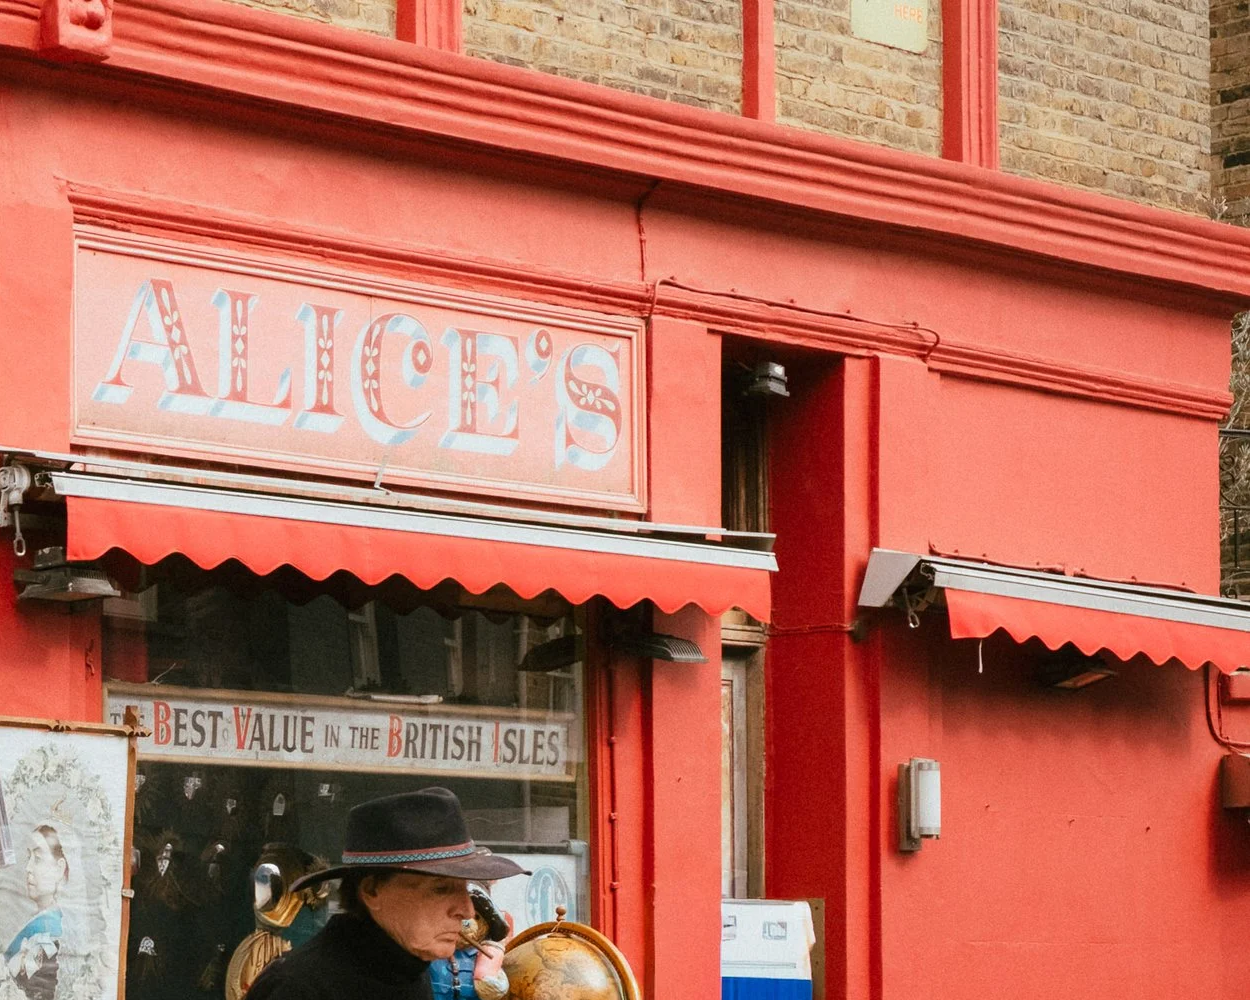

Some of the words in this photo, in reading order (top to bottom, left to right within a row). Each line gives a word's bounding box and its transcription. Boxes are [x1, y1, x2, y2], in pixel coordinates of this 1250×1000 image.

[91, 279, 623, 472] ALICE'S
[153, 701, 224, 749] BEST
[233, 706, 315, 753] VALUE
[324, 724, 341, 748] IN
[349, 726, 380, 750] THE
[386, 713, 482, 762] BRITISH
[492, 720, 560, 766] ISLES
